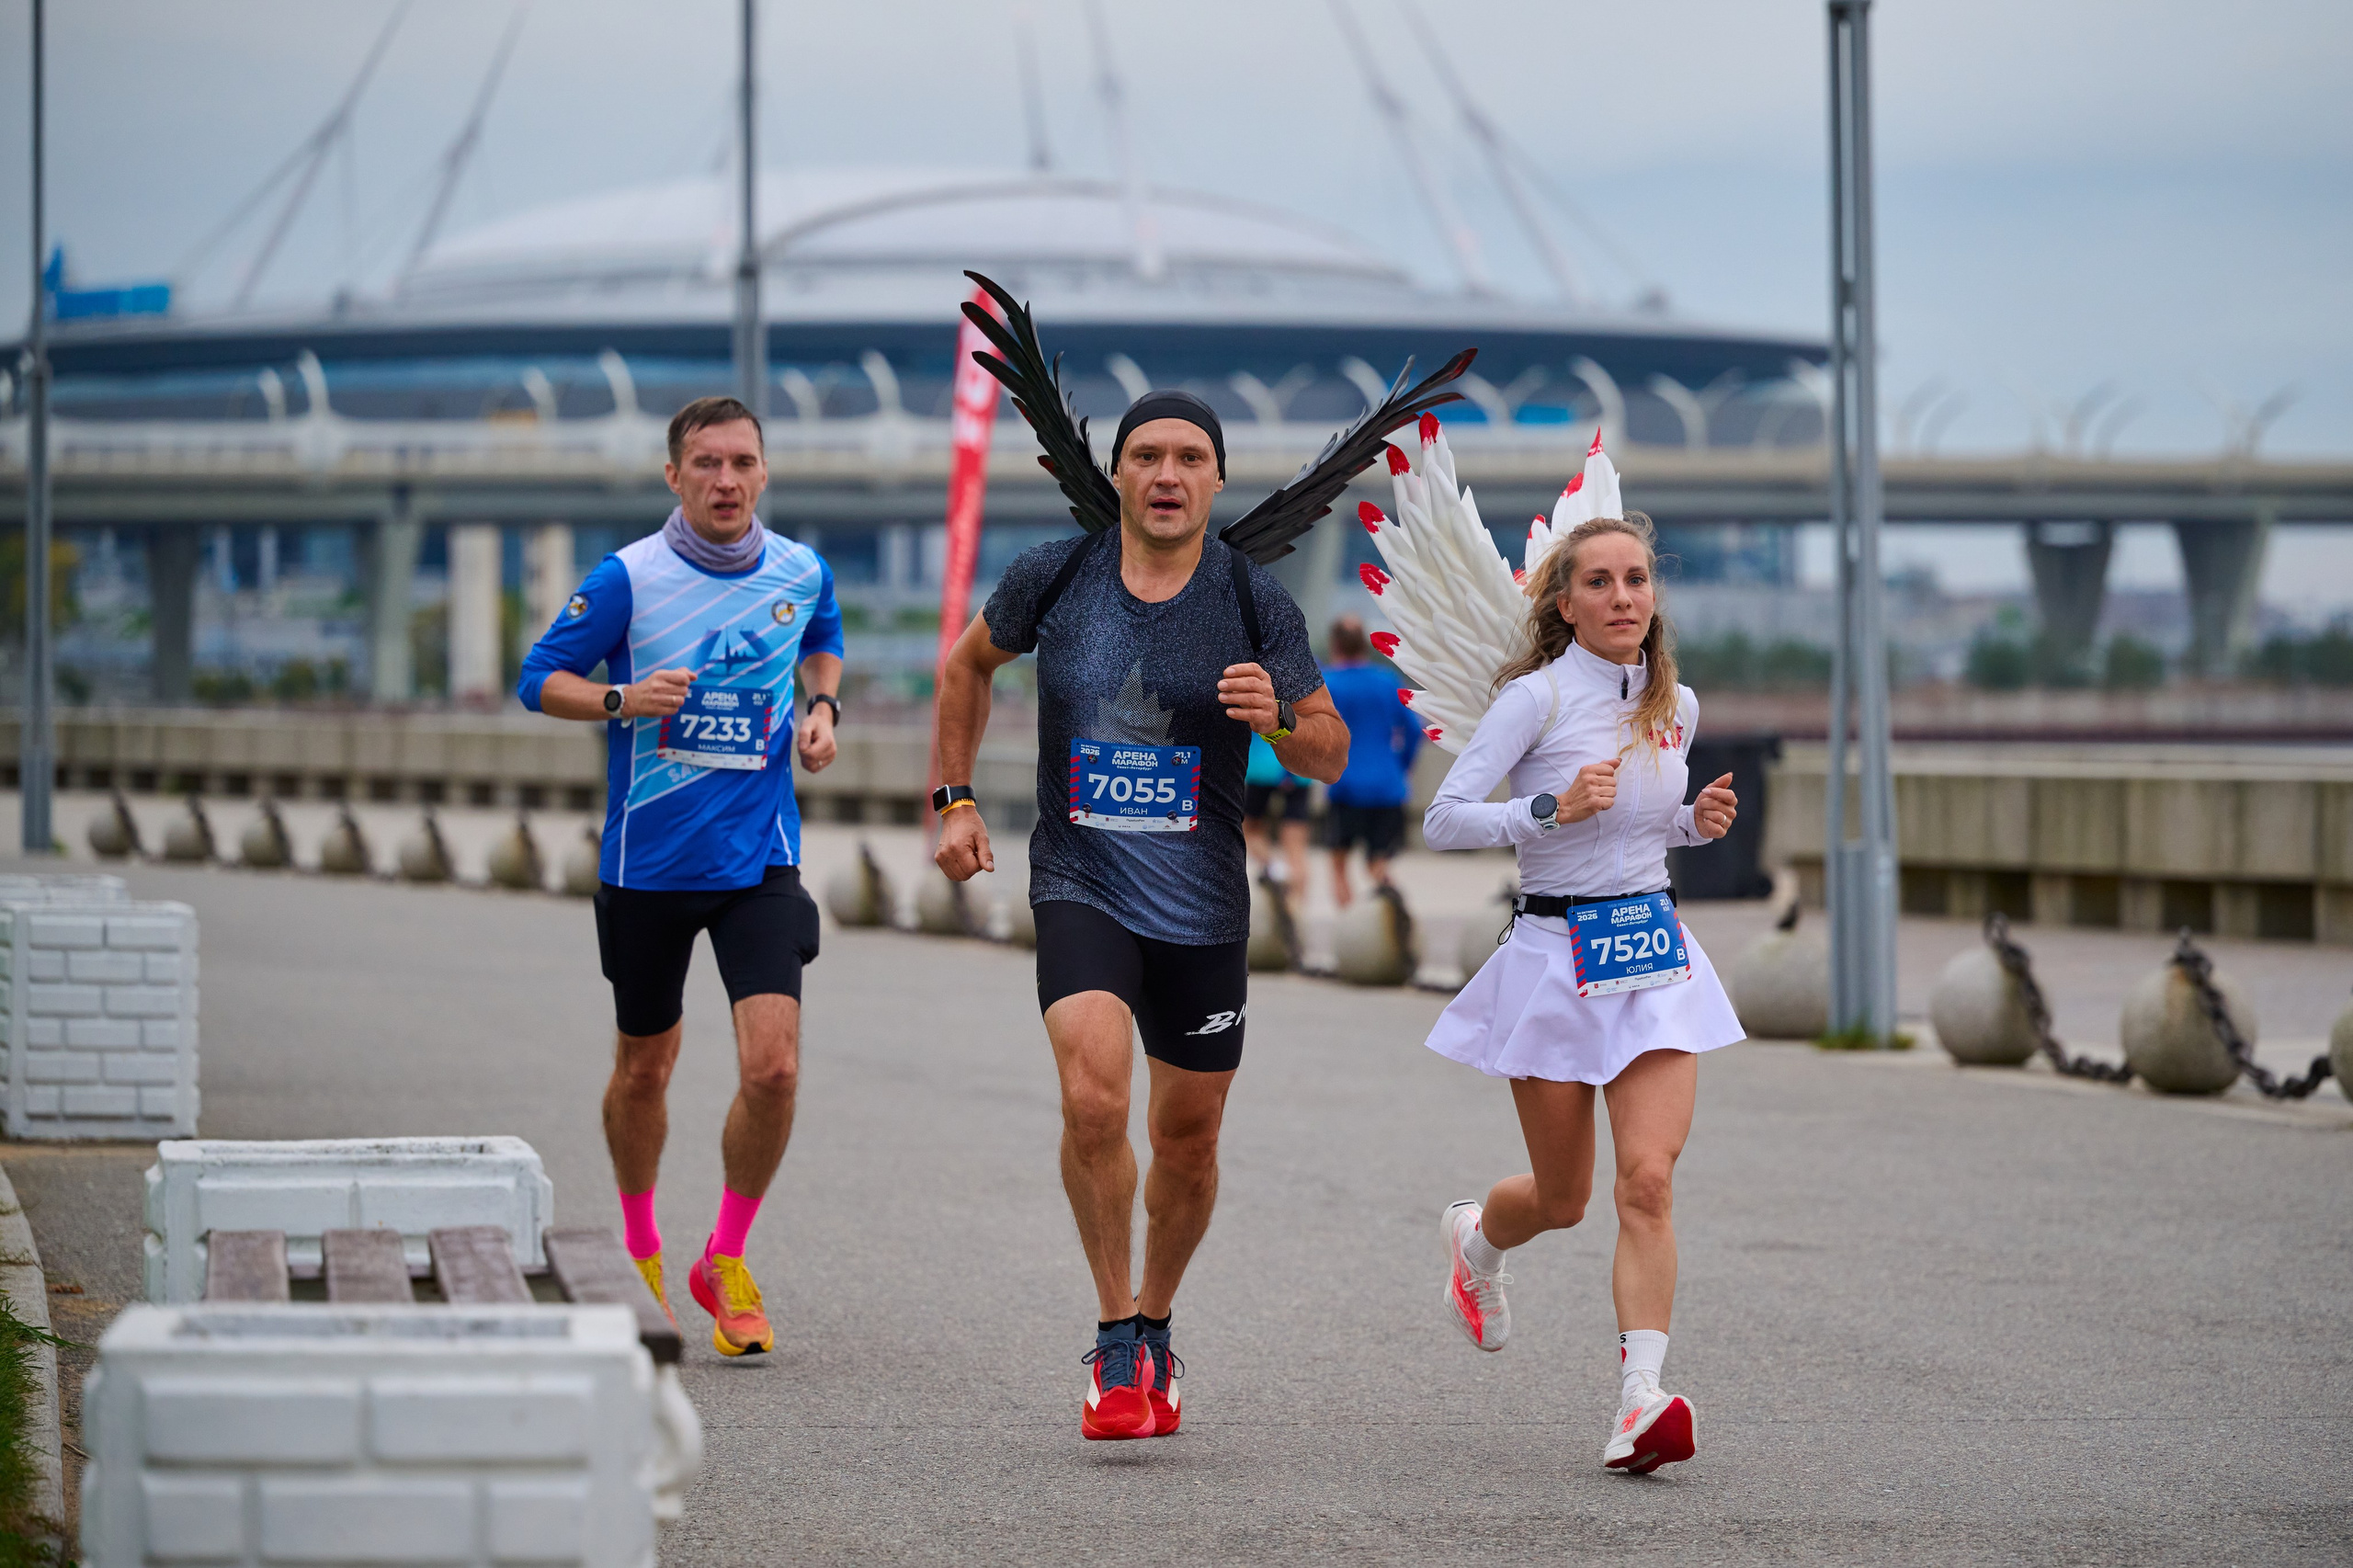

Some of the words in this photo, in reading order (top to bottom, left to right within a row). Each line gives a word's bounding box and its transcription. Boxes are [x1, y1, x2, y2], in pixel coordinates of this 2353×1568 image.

[702, 691, 739, 702] АРЕНА
[679, 713, 751, 743] 7233
[698, 744, 735, 754] МАКСИМ
[1113, 750, 1157, 762] АРЕНА
[1112, 758, 1158, 767] МАРАФОН
[1088, 773, 1176, 803] 7055
[1120, 807, 1148, 815] ИВАН
[1611, 903, 1651, 918] АРЕНА
[1577, 913, 1598, 922] 2026
[1610, 912, 1653, 925] МАРАФОН
[1590, 927, 1670, 965] 7520
[1626, 962, 1654, 974] ЮЛИЯ
